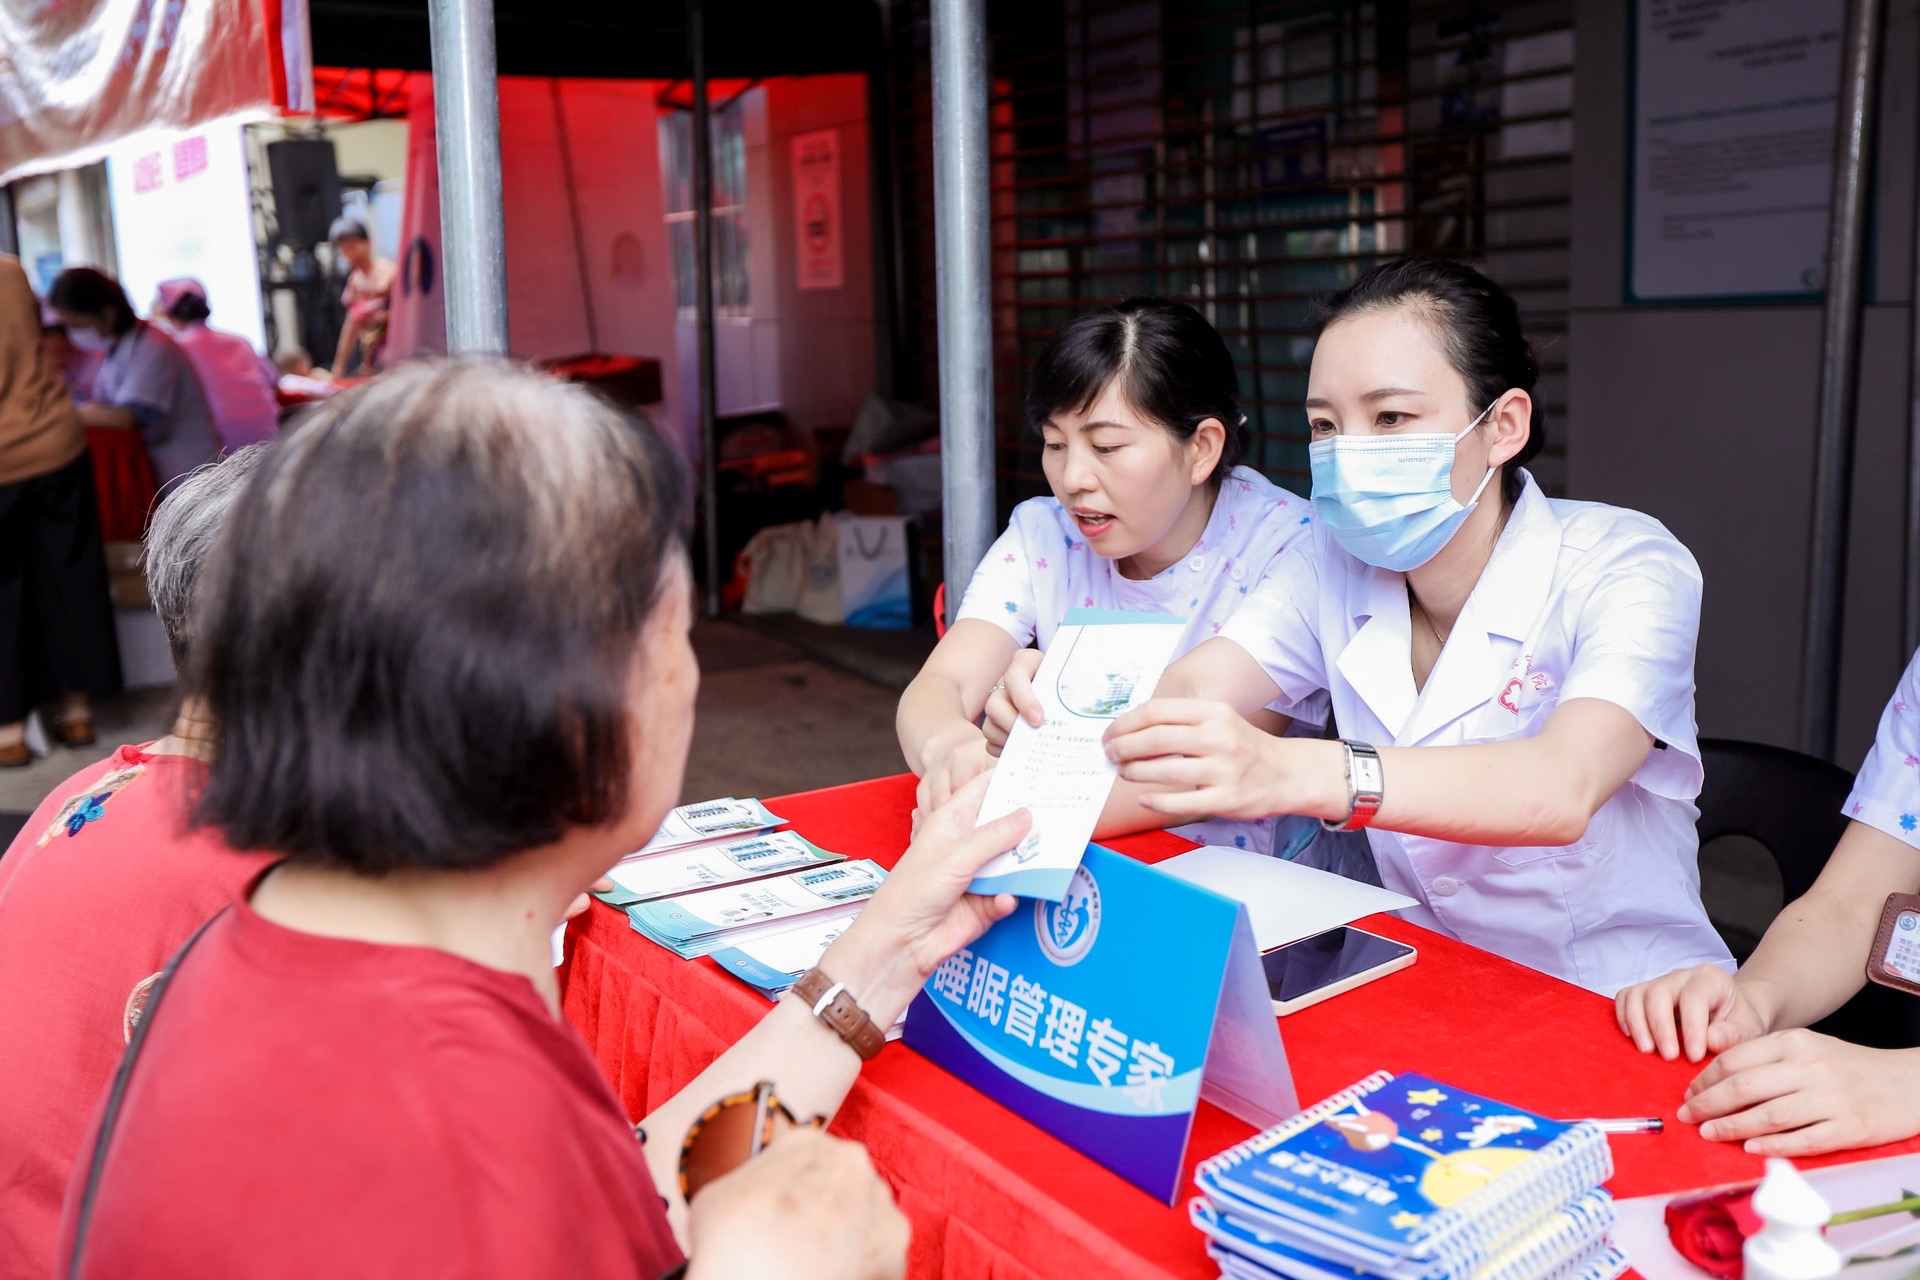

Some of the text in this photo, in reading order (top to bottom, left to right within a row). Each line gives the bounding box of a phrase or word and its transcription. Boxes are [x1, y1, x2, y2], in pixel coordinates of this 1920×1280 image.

[932, 948, 1176, 1113] 睡眠管理专家
